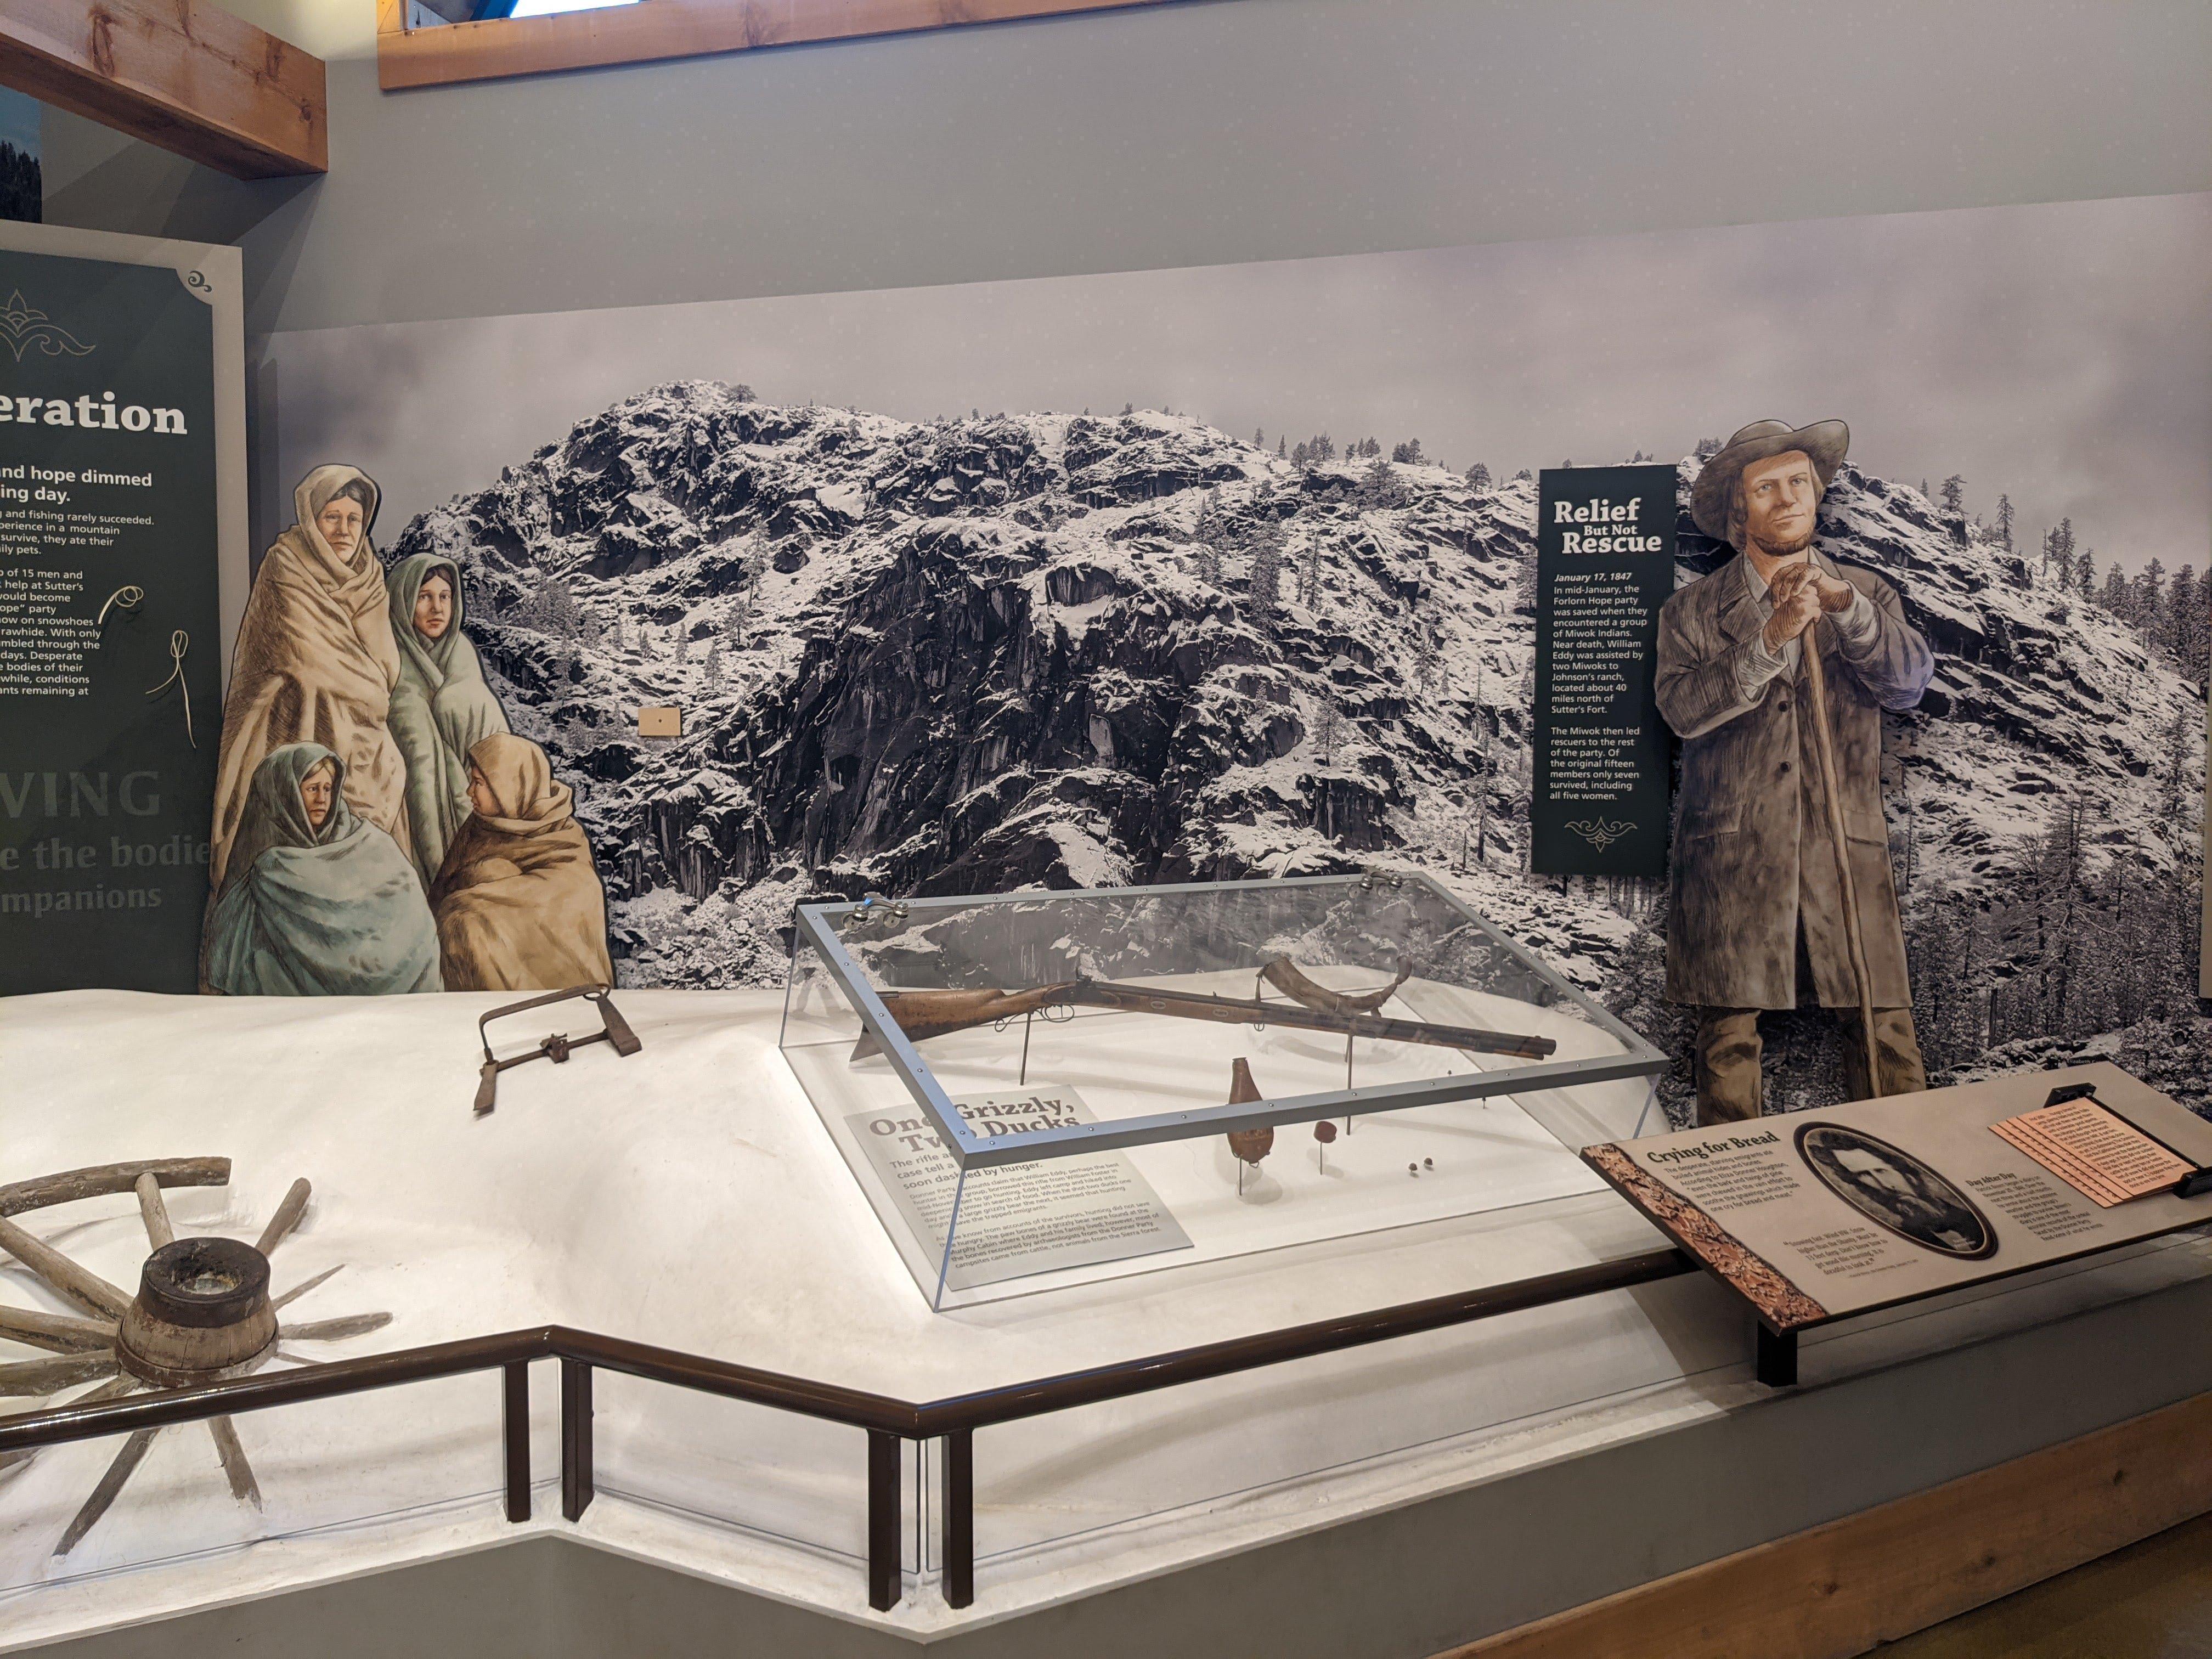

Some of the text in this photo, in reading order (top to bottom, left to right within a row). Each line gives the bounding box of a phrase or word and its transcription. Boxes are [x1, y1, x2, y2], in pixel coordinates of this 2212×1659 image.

[0, 465, 152, 487] nd hope dimmed
[35, 487, 70, 504] day.
[1554, 497, 1641, 523] Relief
[5, 510, 154, 525] and fishing rarely succeeded.
[46, 523, 55, 532] in
[70, 526, 120, 535] mountain
[1584, 524, 1638, 535] But Not
[1, 533, 114, 547] survive, they ate their
[1562, 532, 1662, 554] Rescue
[0, 544, 41, 555] ily pets.
[7, 568, 18, 577] of
[22, 569, 34, 578] 15
[63, 571, 83, 579] and
[1554, 574, 1591, 583] January
[1594, 573, 1606, 582] 17,
[5, 580, 28, 590] help
[31, 582, 42, 590] at
[1565, 585, 1622, 595] mid-January,
[30, 592, 71, 602] become
[1554, 596, 1638, 606] Forlorn Hope party
[29, 605, 57, 615] party
[1628, 607, 1647, 616] they
[37, 617, 94, 627] snowshoes
[1553, 618, 1609, 627] encountered
[1620, 619, 1647, 628] group
[1, 627, 101, 640] rawhide. With only
[1553, 629, 1562, 637] of
[37, 639, 80, 651] through
[83, 640, 100, 649] the
[1576, 640, 1604, 649] death,
[1, 650, 83, 661] days. Desperate
[1553, 651, 1574, 661] Eddy
[1596, 651, 1629, 659] assisted
[1633, 650, 1643, 661] by
[7, 662, 83, 672] bodies of their
[36, 674, 89, 684] conditions
[1597, 673, 1624, 682] ranch,
[22, 686, 75, 697] remaining
[1604, 694, 1614, 702] of
[1551, 748, 1620, 758] of the party. Of
[1550, 759, 1634, 769] the original fifteen
[1593, 770, 1612, 780] only
[1550, 781, 1632, 791] survived, including
[32, 838, 97, 870] the
[2, 884, 162, 918] mpanions
[870, 1097, 1074, 1136] One Grizzly,
[1647, 1131, 1781, 1163] Crying for Bread
[890, 1154, 941, 1170] The rifle
[897, 1169, 923, 1179] case
[925, 1163, 944, 1173] tell
[904, 1179, 932, 1190] soon
[1000, 1162, 1043, 1173] hunger.
[1024, 1171, 1049, 1180] William
